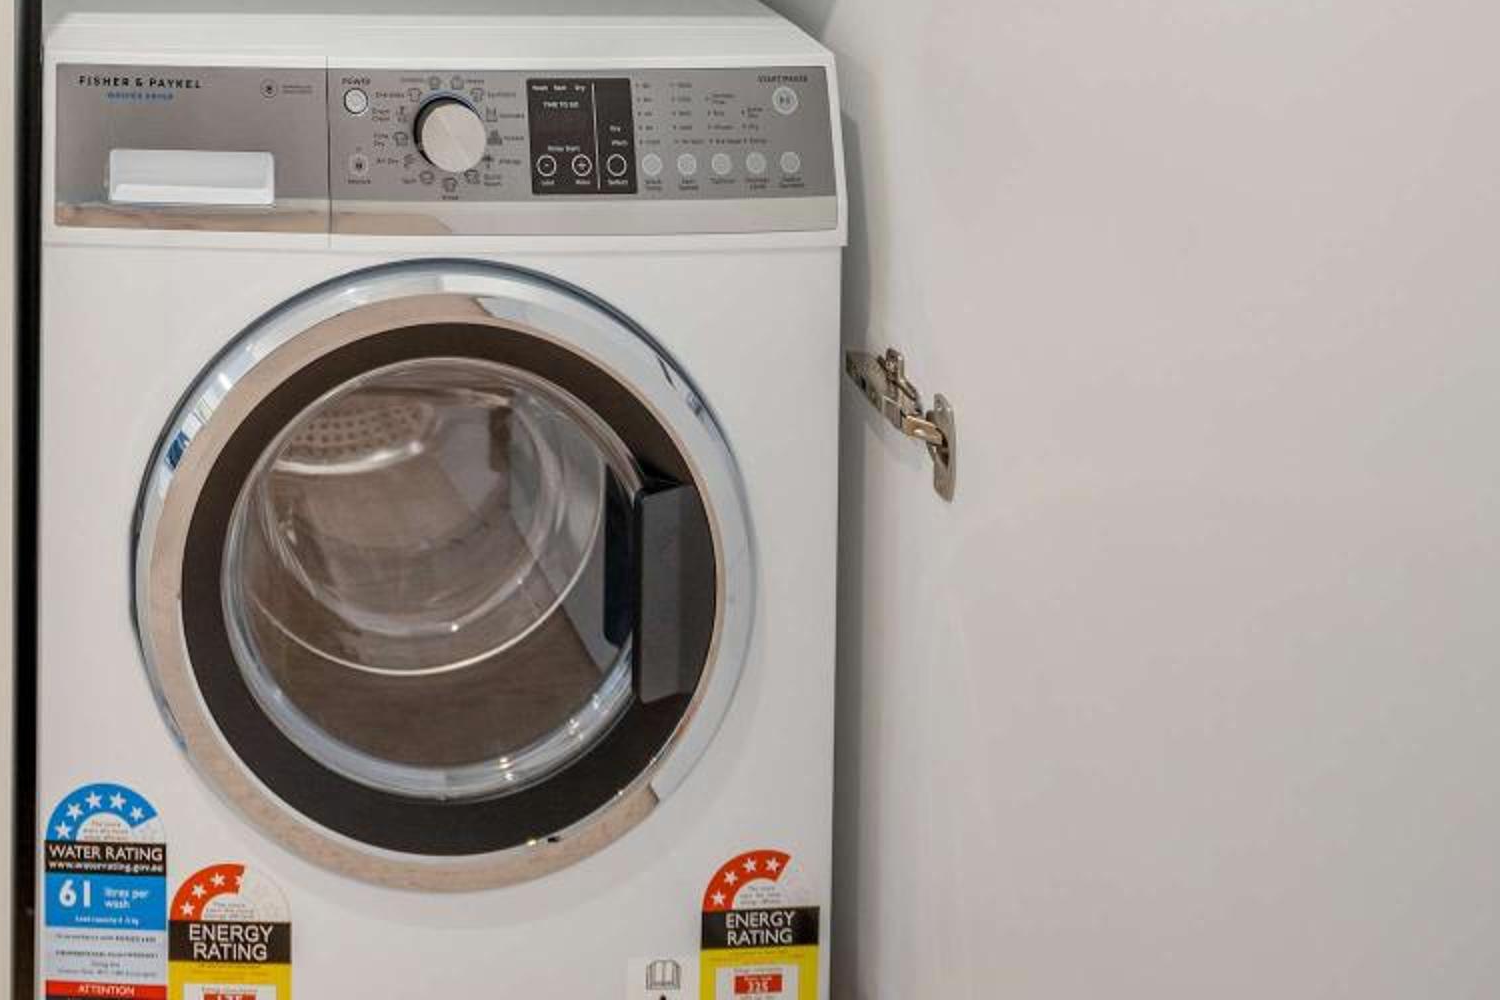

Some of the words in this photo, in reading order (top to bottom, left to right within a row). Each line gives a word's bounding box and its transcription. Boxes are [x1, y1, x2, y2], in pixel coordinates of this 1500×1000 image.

[79, 75, 129, 87] FISHER
[135, 77, 143, 87] &
[150, 78, 201, 89] PAYKEL
[49, 844, 101, 860] WATER
[105, 846, 164, 861] RATING
[59, 879, 92, 908] 61
[131, 889, 149, 900] per
[103, 899, 131, 909] wash
[725, 911, 795, 929] ENERGY
[188, 923, 274, 943] ENERGY
[726, 928, 793, 946] RATING
[193, 942, 268, 961] RATING
[77, 983, 135, 998] ATTENTION
